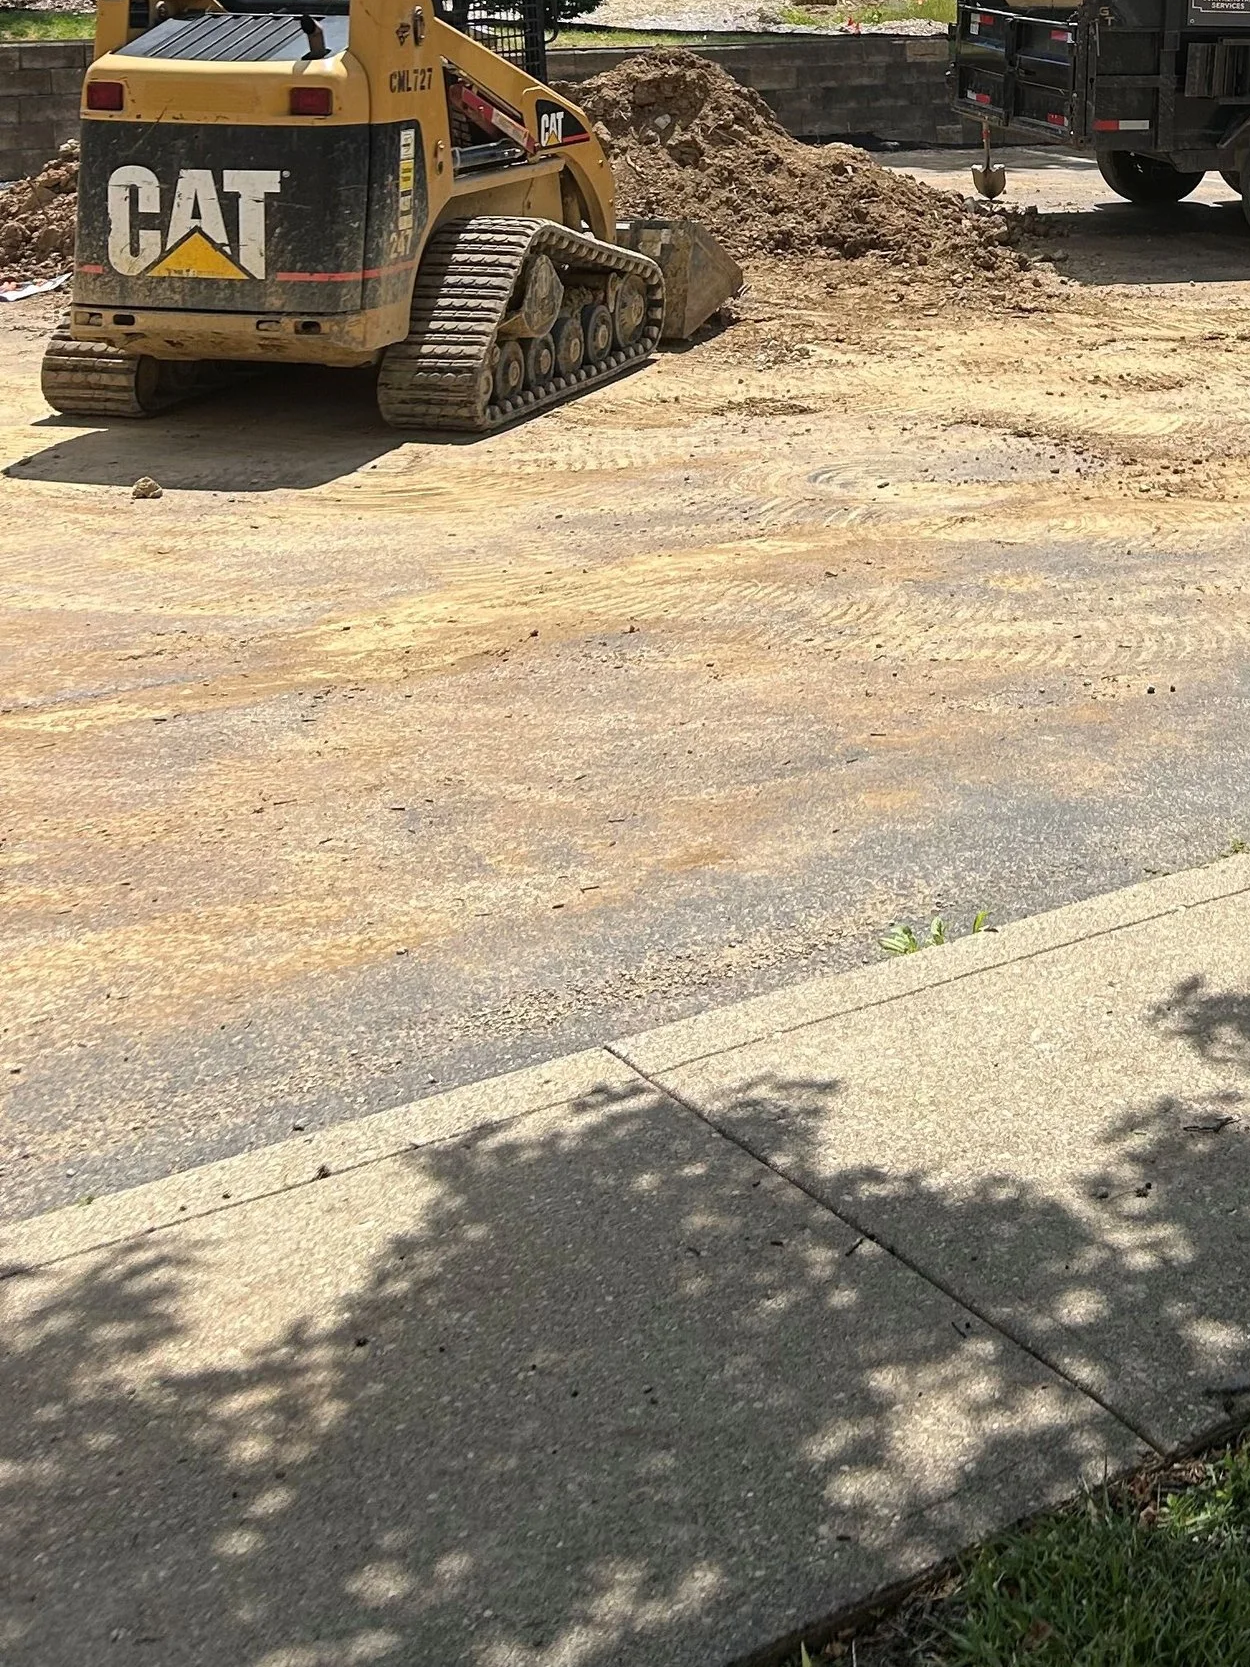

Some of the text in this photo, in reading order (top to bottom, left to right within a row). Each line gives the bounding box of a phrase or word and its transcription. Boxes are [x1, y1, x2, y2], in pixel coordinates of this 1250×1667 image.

[1211, 2, 1245, 10] SERVICES
[389, 67, 433, 94] CML727
[541, 111, 564, 147] CAT
[107, 165, 281, 280] CAT
